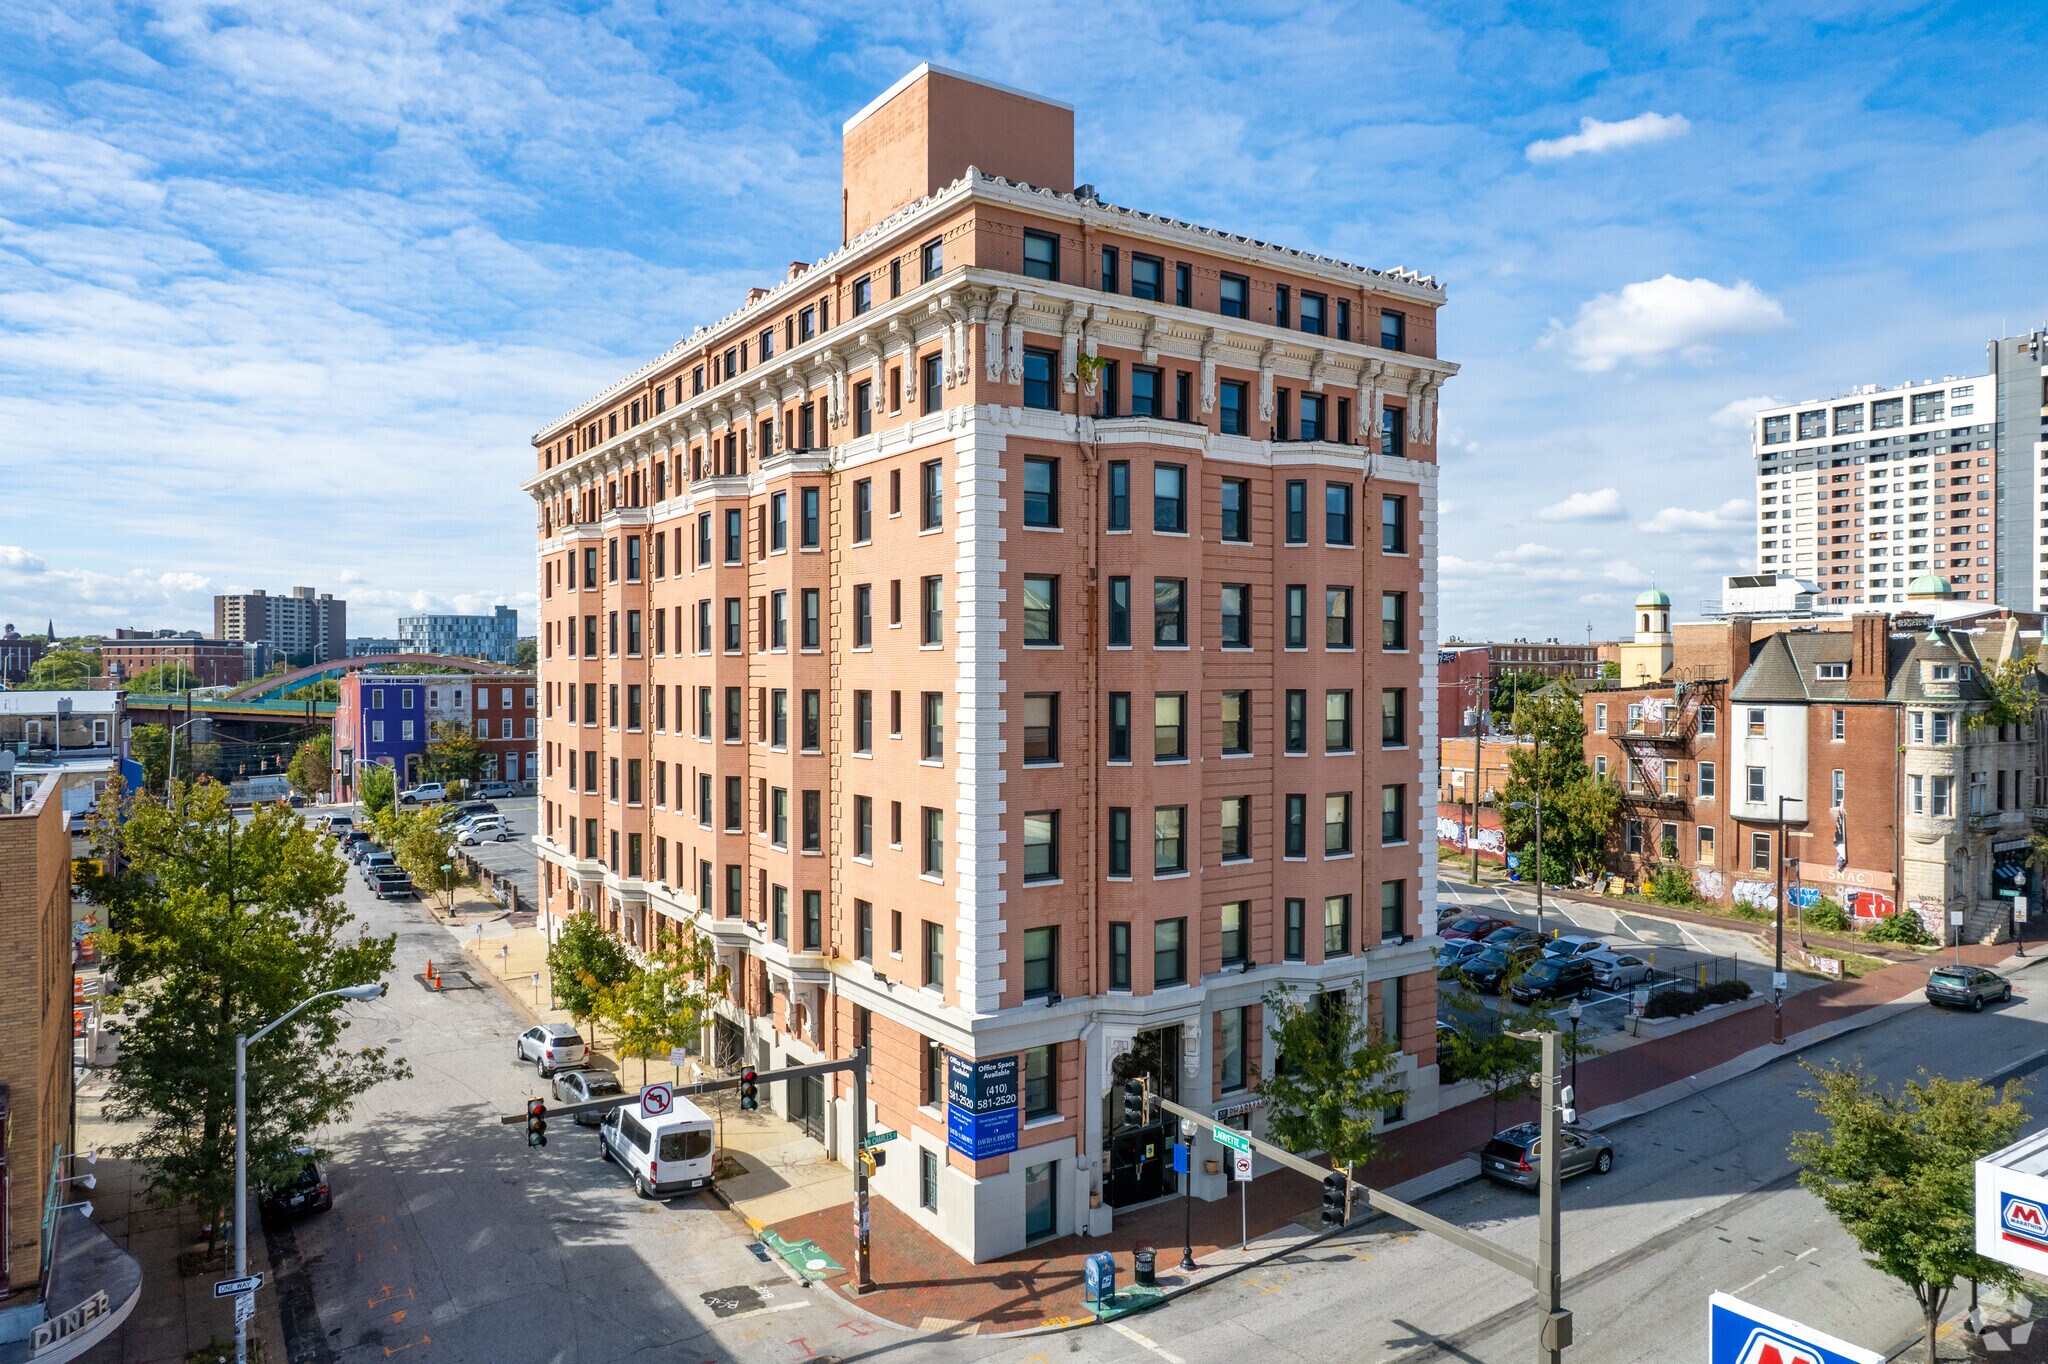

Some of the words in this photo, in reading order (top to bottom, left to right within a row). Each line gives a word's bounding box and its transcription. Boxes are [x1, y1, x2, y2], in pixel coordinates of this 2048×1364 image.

[1828, 869, 1865, 883] SNAC
[949, 1056, 961, 1066] Office
[961, 1061, 973, 1072] Space
[978, 1063, 997, 1073] Office
[997, 1061, 1015, 1070] Space
[952, 1065, 970, 1079] Available
[983, 1068, 1011, 1079] Available
[953, 1080, 968, 1096] (410)
[986, 1083, 1008, 1097] (410)
[949, 1089, 974, 1109] 581-2520
[977, 1093, 1017, 1110] 581-2520
[2010, 1217, 2043, 1231] MARATHON
[220, 1284, 235, 1293] ONE
[236, 1281, 252, 1289] WAY
[33, 1293, 111, 1351] DINER
